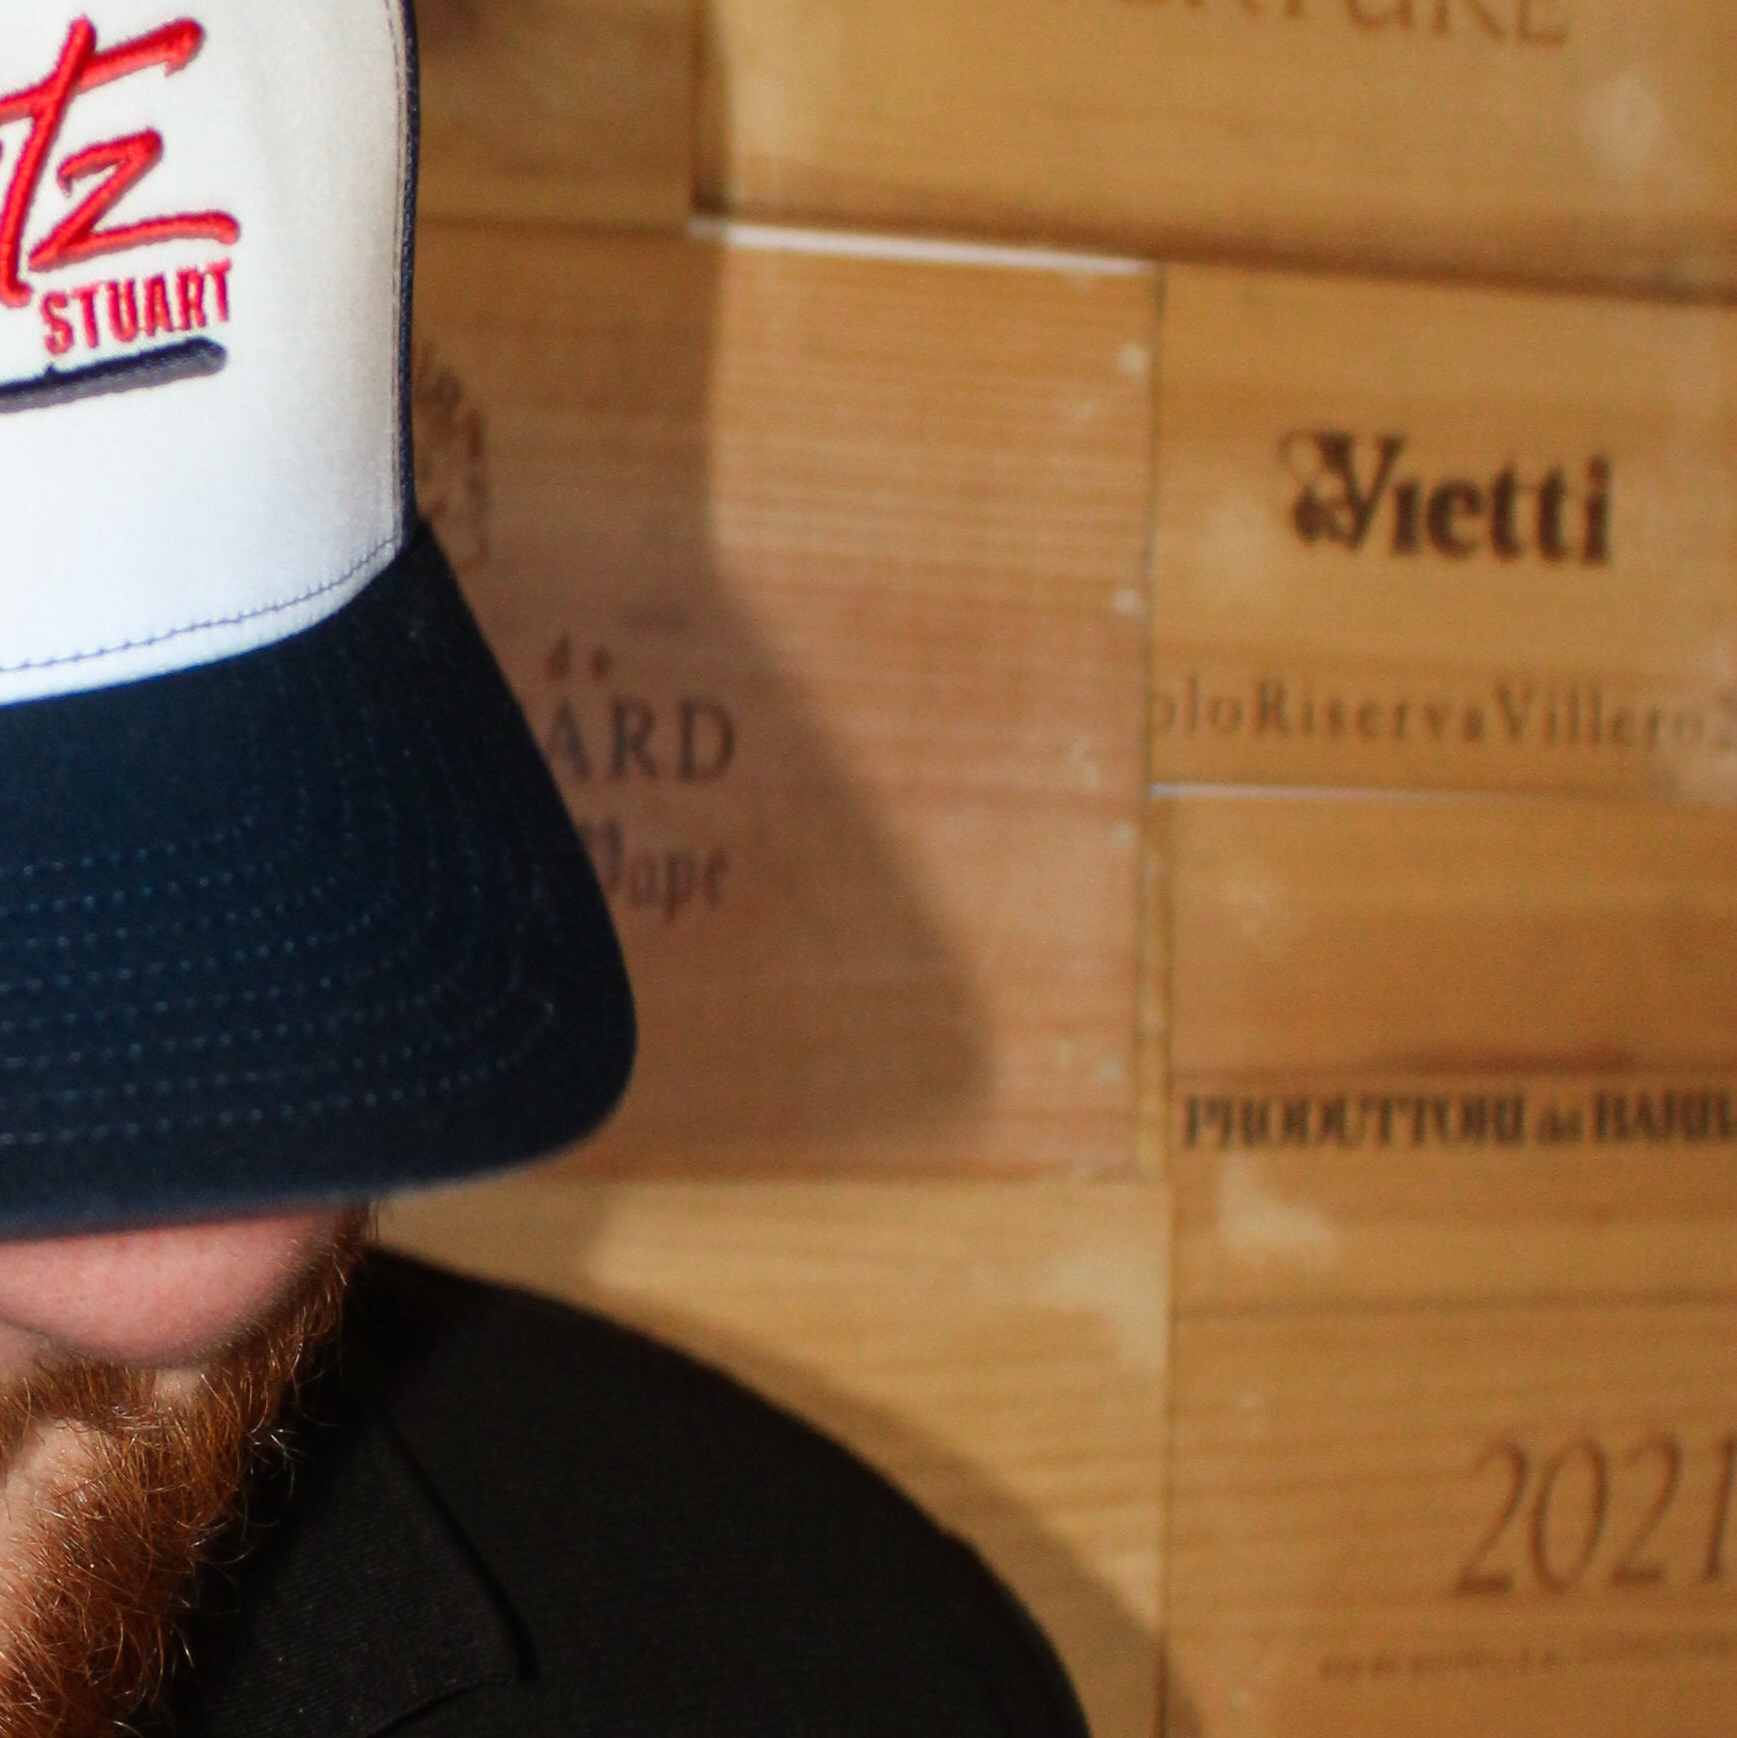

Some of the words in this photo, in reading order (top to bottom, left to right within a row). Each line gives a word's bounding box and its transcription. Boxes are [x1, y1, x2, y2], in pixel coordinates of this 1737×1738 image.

[39, 256, 234, 357] STUART
[1276, 428, 1613, 569] Vietti
[1452, 1431, 1737, 1595] 2021
